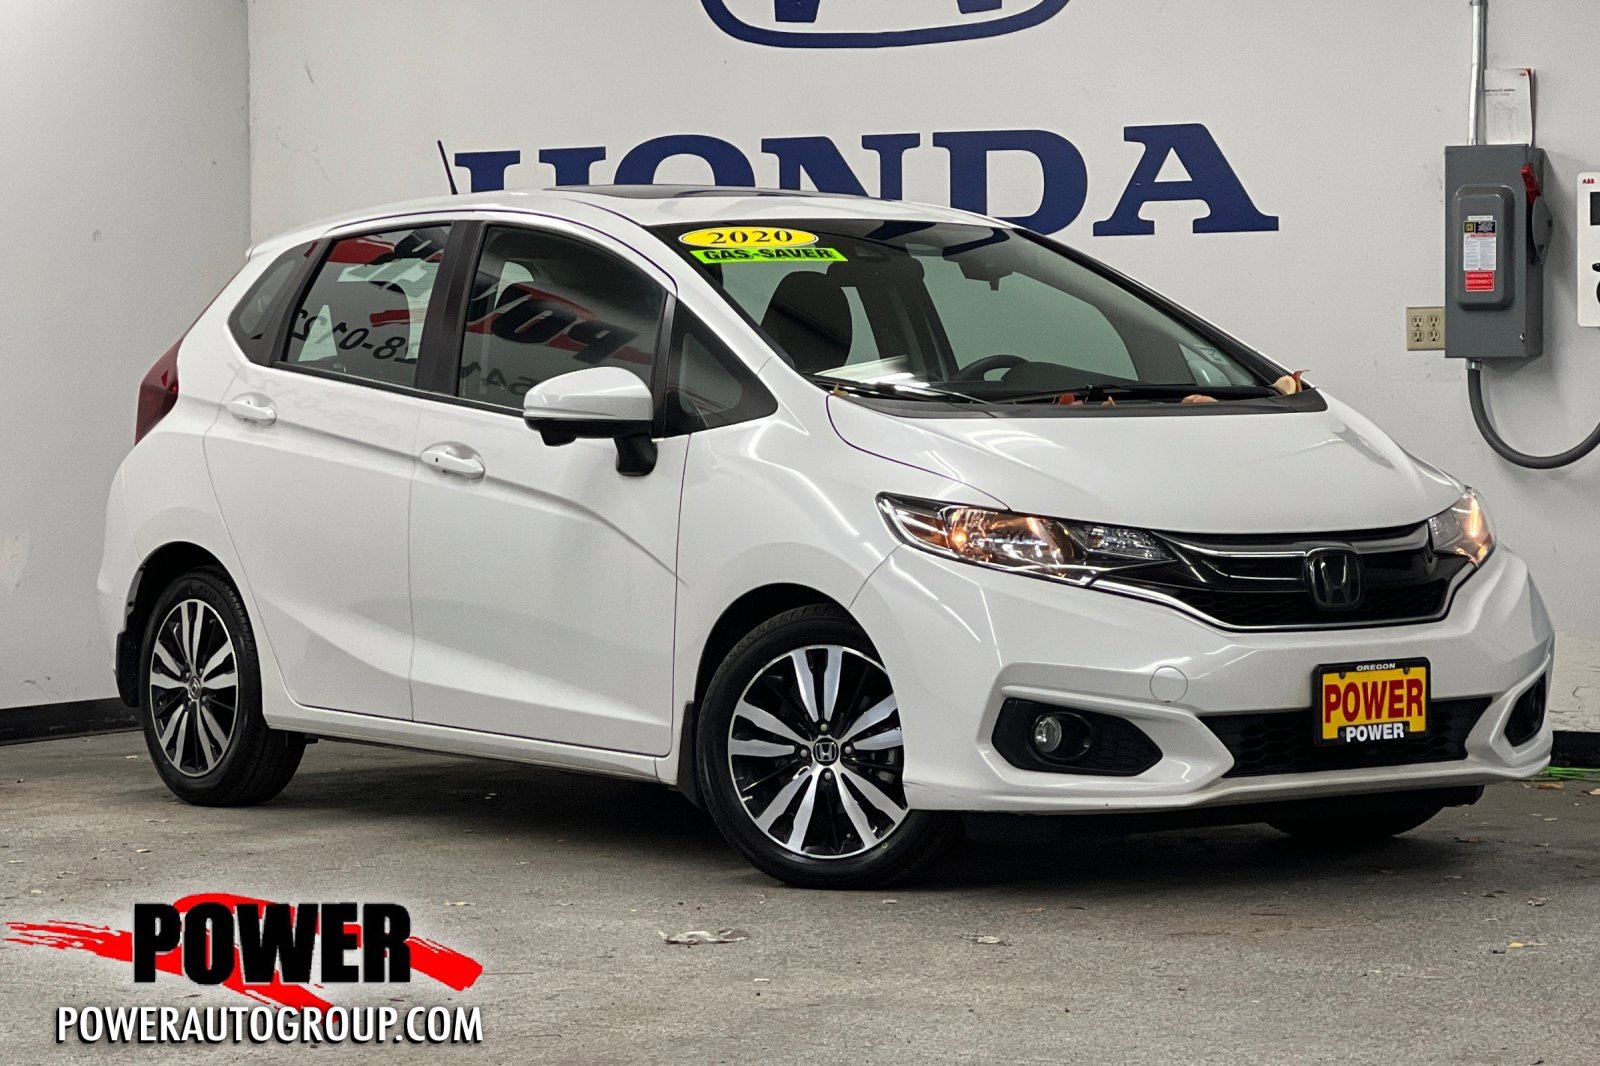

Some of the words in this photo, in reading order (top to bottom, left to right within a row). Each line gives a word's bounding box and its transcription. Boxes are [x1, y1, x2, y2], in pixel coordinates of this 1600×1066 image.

[707, 230, 793, 244] 2020
[703, 248, 833, 260] GAS-SAVER
[1356, 663, 1396, 671] OREGON
[1324, 678, 1423, 723] POWER
[1345, 722, 1405, 742] POWER
